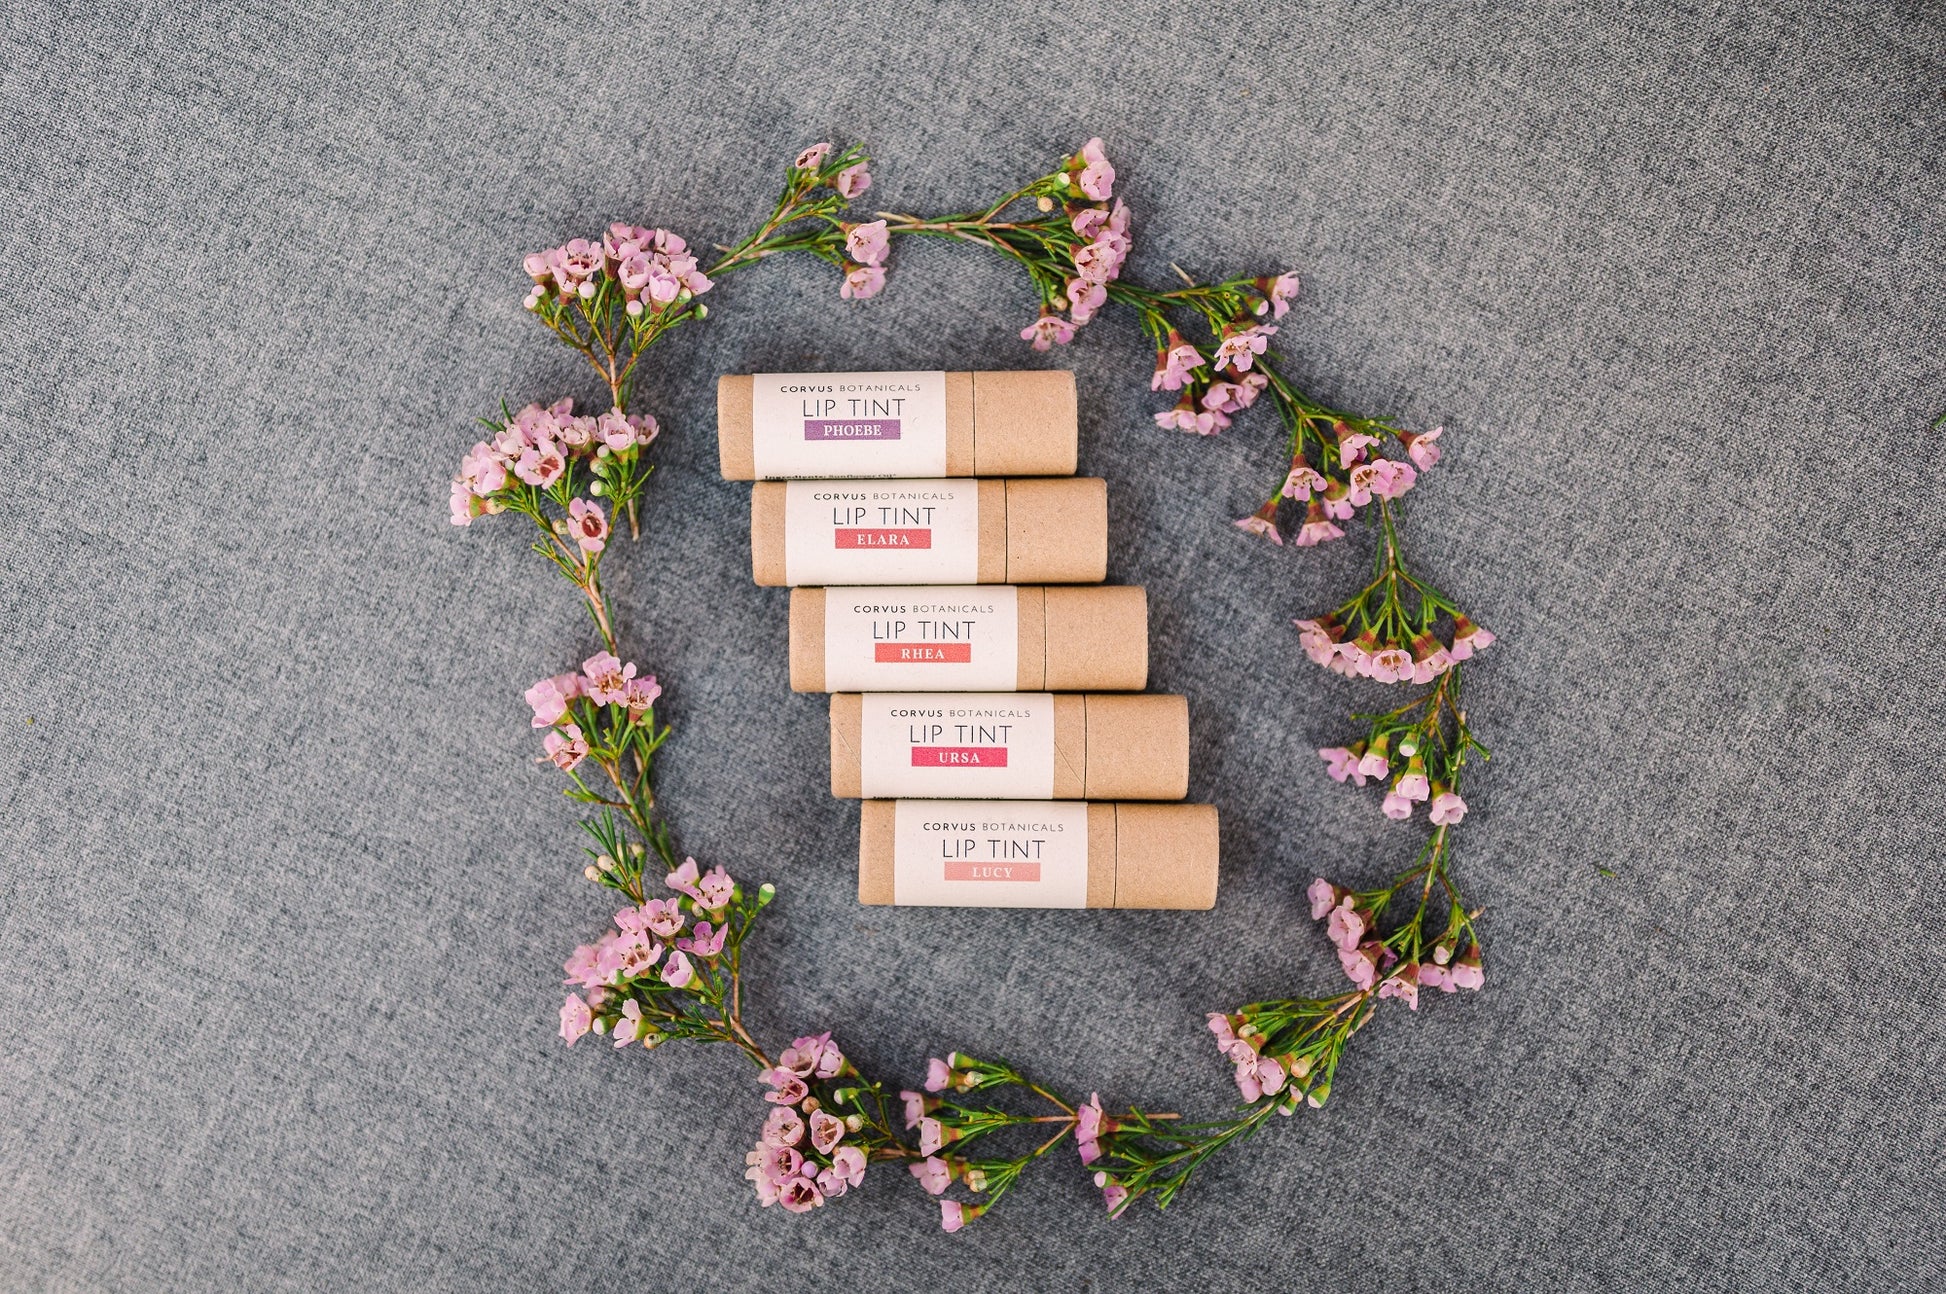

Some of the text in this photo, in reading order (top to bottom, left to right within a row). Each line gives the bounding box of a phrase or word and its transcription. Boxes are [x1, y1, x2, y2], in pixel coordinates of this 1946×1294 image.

[780, 384, 921, 393] CORVUS BOTANICALS
[803, 398, 906, 417] LIP TINT
[823, 424, 882, 437] PHOEBE
[814, 492, 954, 501] CORVUS BOTANICALS
[833, 506, 936, 525] LIP TINT
[857, 533, 910, 546] ELARA
[853, 604, 994, 614] CORVUS BOTANICALS
[873, 620, 976, 639] LIP TINT
[901, 648, 946, 660] RHEA
[890, 709, 1031, 718] CORVUS BOTANICALS
[909, 724, 1013, 744] LIP TINT
[939, 752, 981, 764] URSA
[922, 822, 1064, 832] CORVUS BOTANICALS
[942, 839, 1046, 859] LIP TINT
[972, 867, 1013, 878] LUCY
